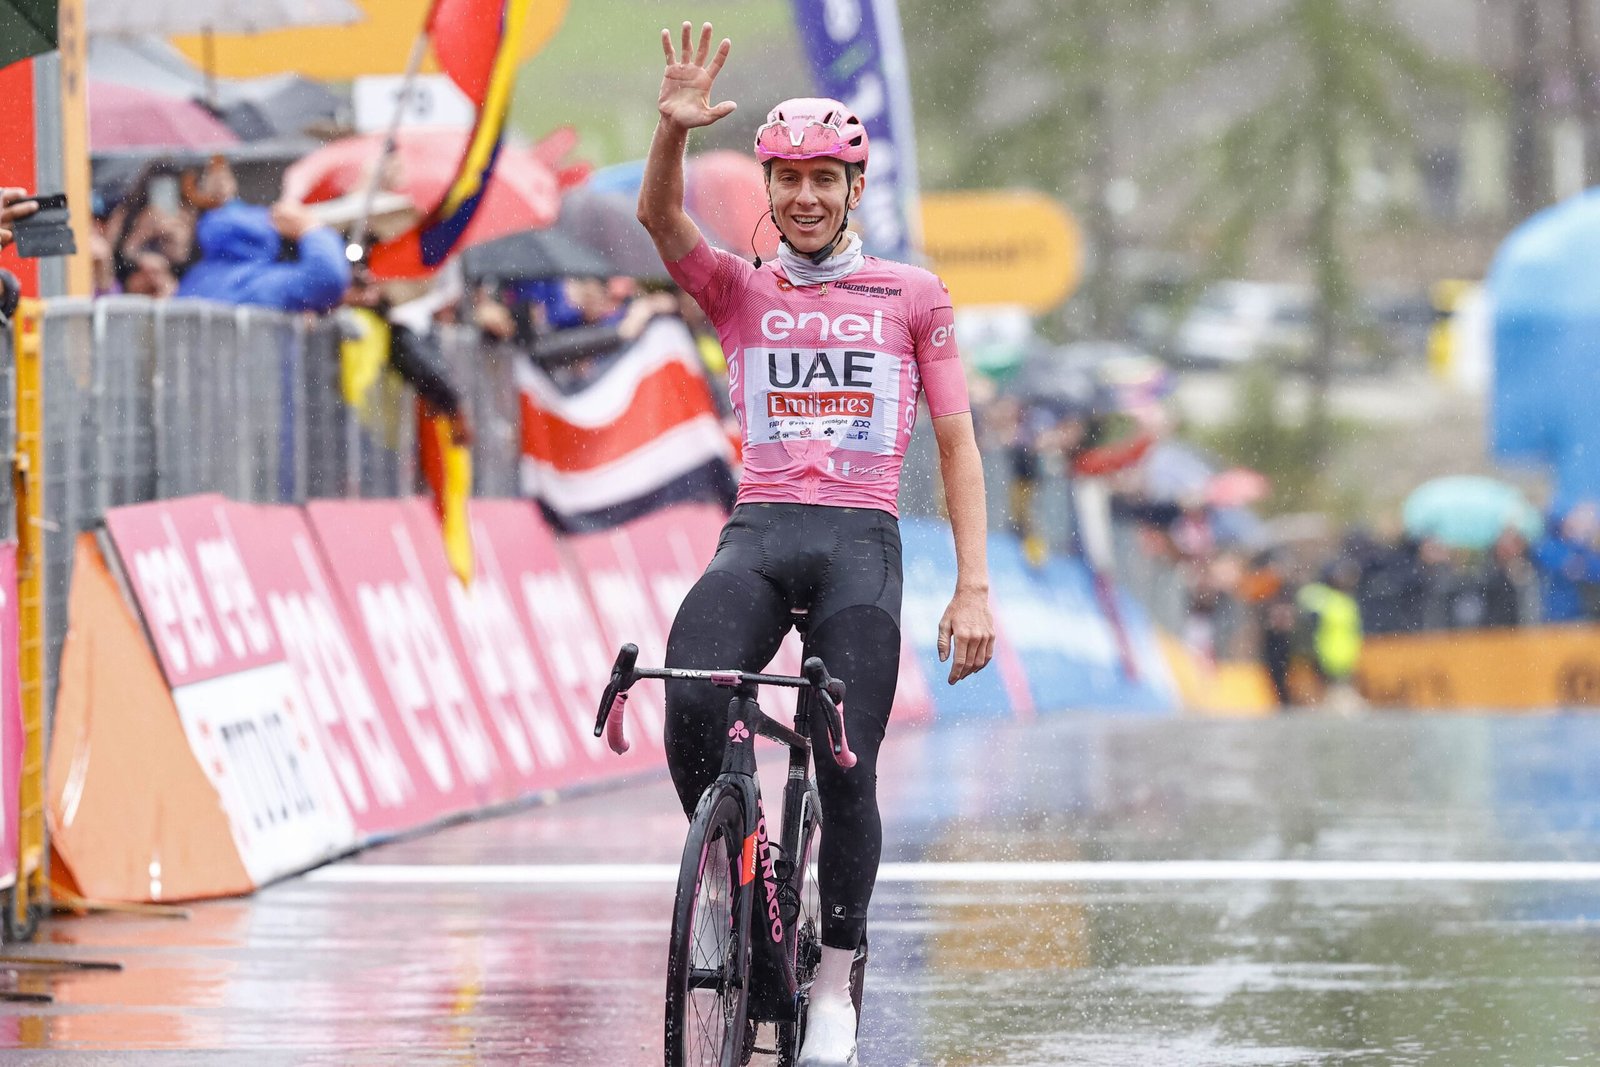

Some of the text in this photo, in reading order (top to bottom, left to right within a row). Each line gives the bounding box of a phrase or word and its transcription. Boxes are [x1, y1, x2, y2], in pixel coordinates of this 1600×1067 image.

[842, 282, 869, 293] Gazzetta
[869, 285, 885, 295] dello
[885, 286, 902, 297] Sport
[761, 309, 885, 345] enel
[768, 351, 876, 389] UAE
[769, 394, 870, 415] Emirates
